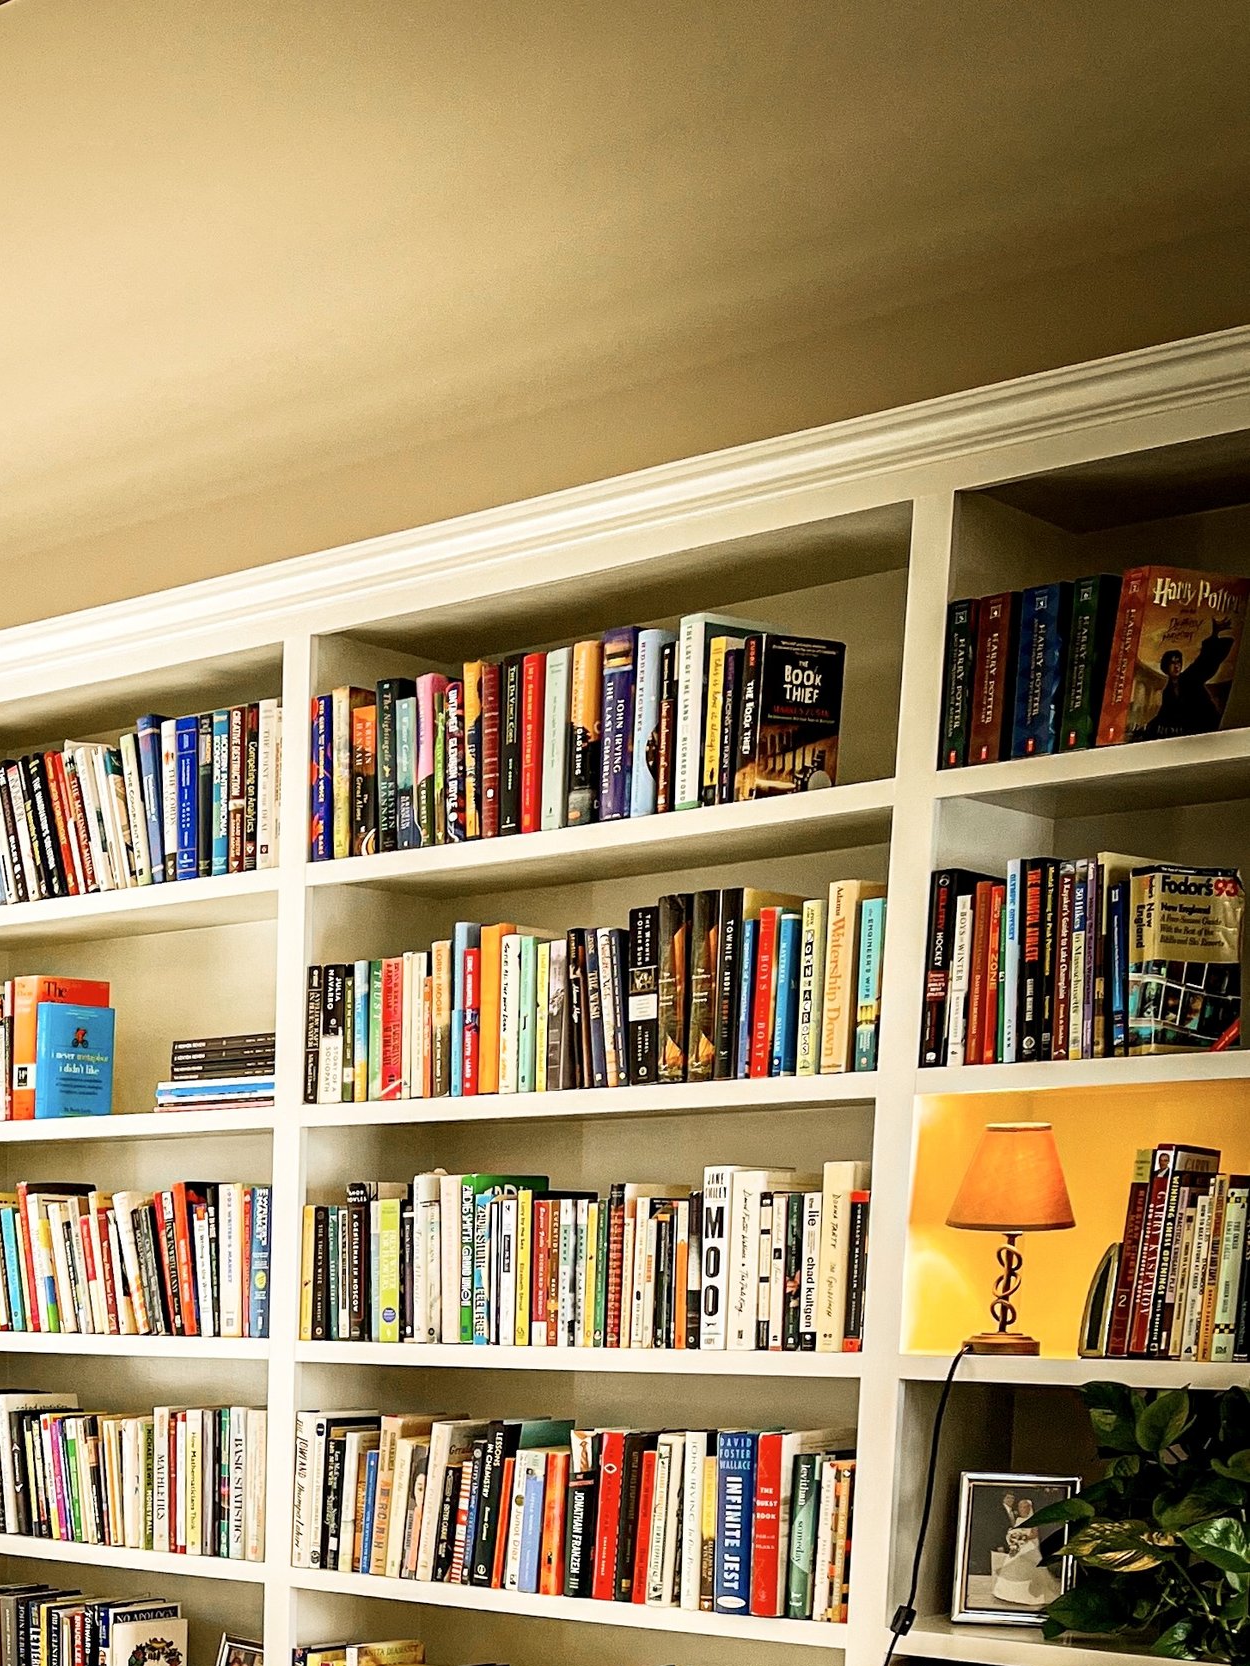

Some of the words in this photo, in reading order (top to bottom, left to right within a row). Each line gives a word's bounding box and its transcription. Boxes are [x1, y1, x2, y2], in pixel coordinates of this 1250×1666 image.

[1153, 578, 1196, 607] Harry
[1036, 624, 1046, 667] HARRY
[1079, 616, 1090, 659] HARRY
[1125, 609, 1137, 653] HARRY
[956, 638, 966, 680] HARRY
[989, 633, 999, 675] HARRY
[606, 682, 614, 700] THE
[783, 684, 819, 704] THIEF
[784, 665, 822, 686] BOOK
[1032, 673, 1043, 716] POTTER
[1074, 665, 1086, 708] POTTER
[1115, 659, 1128, 703] POTTER
[383, 693, 391, 710] The
[449, 689, 458, 732] UNTAMED
[604, 708, 613, 733] LAST
[616, 699, 625, 729] JOHN
[953, 686, 963, 728] POTTER
[985, 681, 995, 723] POTTER
[232, 711, 240, 745] CREATIVE
[355, 723, 363, 766] HANNAH
[382, 713, 390, 761] Nightingale
[232, 747, 240, 796] DESTRUCTION
[247, 742, 256, 784] Competing
[448, 738, 457, 778] GLENNON
[602, 737, 611, 794] CHAIRLIFT
[613, 734, 624, 773] IRVING
[248, 786, 256, 796] on
[387, 781, 395, 829] KRISTIN
[246, 798, 255, 833] Analytics
[835, 886, 844, 916] Adams
[1061, 884, 1070, 916] Kayaker's
[1161, 875, 1213, 896] Fodor's
[1214, 879, 1238, 896] 93
[1061, 918, 1069, 937] Guide
[1136, 904, 1145, 948] England
[1160, 902, 1176, 913] New
[1179, 904, 1210, 914] England
[725, 920, 734, 961] TOWNIE
[826, 917, 846, 1000] Watership
[865, 919, 874, 973] ENGINEER'S
[934, 932, 947, 966] HOCKEY
[44, 981, 67, 998] The
[327, 969, 335, 1009] NAVARRO
[990, 953, 998, 990] ZONE
[1058, 964, 1068, 999] Champlain
[824, 1006, 840, 1056] Down
[332, 1074, 338, 1084] OF
[1151, 1191, 1166, 1235] GARRY
[1167, 1176, 1179, 1218] WINNING
[807, 1210, 819, 1226] lie
[1164, 1222, 1173, 1247] CHESS
[806, 1257, 815, 1284] chad
[1140, 1245, 1162, 1315] KASPAROV
[1158, 1250, 1170, 1295] OPENINGS
[804, 1288, 815, 1328] kultgen
[234, 1438, 242, 1474] BASIC
[487, 1444, 493, 1453] IN
[494, 1432, 503, 1466] LESSONS
[720, 1449, 750, 1458] FOSTER
[721, 1438, 752, 1447] DAVID
[482, 1455, 492, 1497] CHEMISTRY
[720, 1460, 750, 1470] WALLACE
[798, 1464, 809, 1505] levithan
[234, 1477, 242, 1543] STATISTICS
[572, 1491, 585, 1533] JONATHAN
[725, 1476, 742, 1547] INFINITE
[570, 1535, 582, 1573] FRANZEN
[793, 1520, 805, 1564] someday
[723, 1554, 739, 1590] JEST
